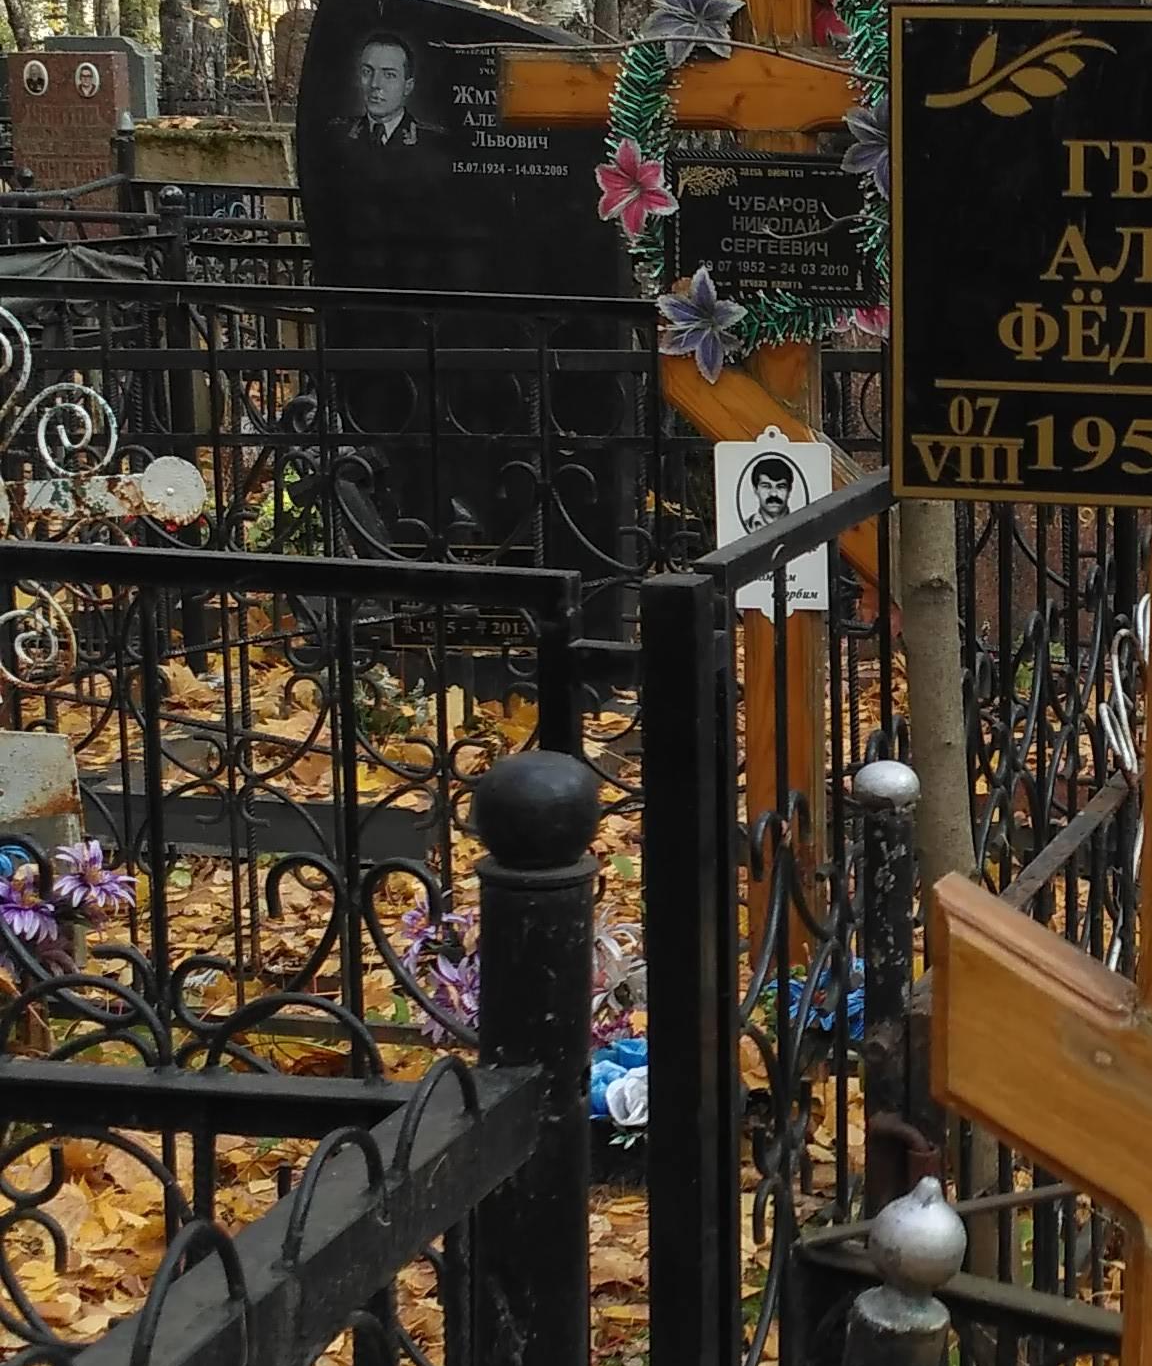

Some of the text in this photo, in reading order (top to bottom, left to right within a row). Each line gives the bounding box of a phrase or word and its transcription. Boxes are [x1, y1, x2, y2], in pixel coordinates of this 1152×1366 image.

[452, 162, 505, 174] 15.07.1924
[515, 163, 569, 177] 14.03.2005
[728, 195, 819, 214] ЧУБАРОВ
[732, 214, 820, 234] НИКОЛАЙ
[720, 237, 829, 257] СЕРГЕЕВИЧ
[718, 260, 732, 272] 07
[738, 261, 766, 273] 1952
[780, 262, 796, 274] 24
[801, 263, 817, 276] 03
[820, 264, 849, 277] 2010
[948, 395, 1000, 436] 07
[771, 588, 819, 602] србим
[418, 620, 457, 635] 195
[491, 621, 530, 636] 2013
